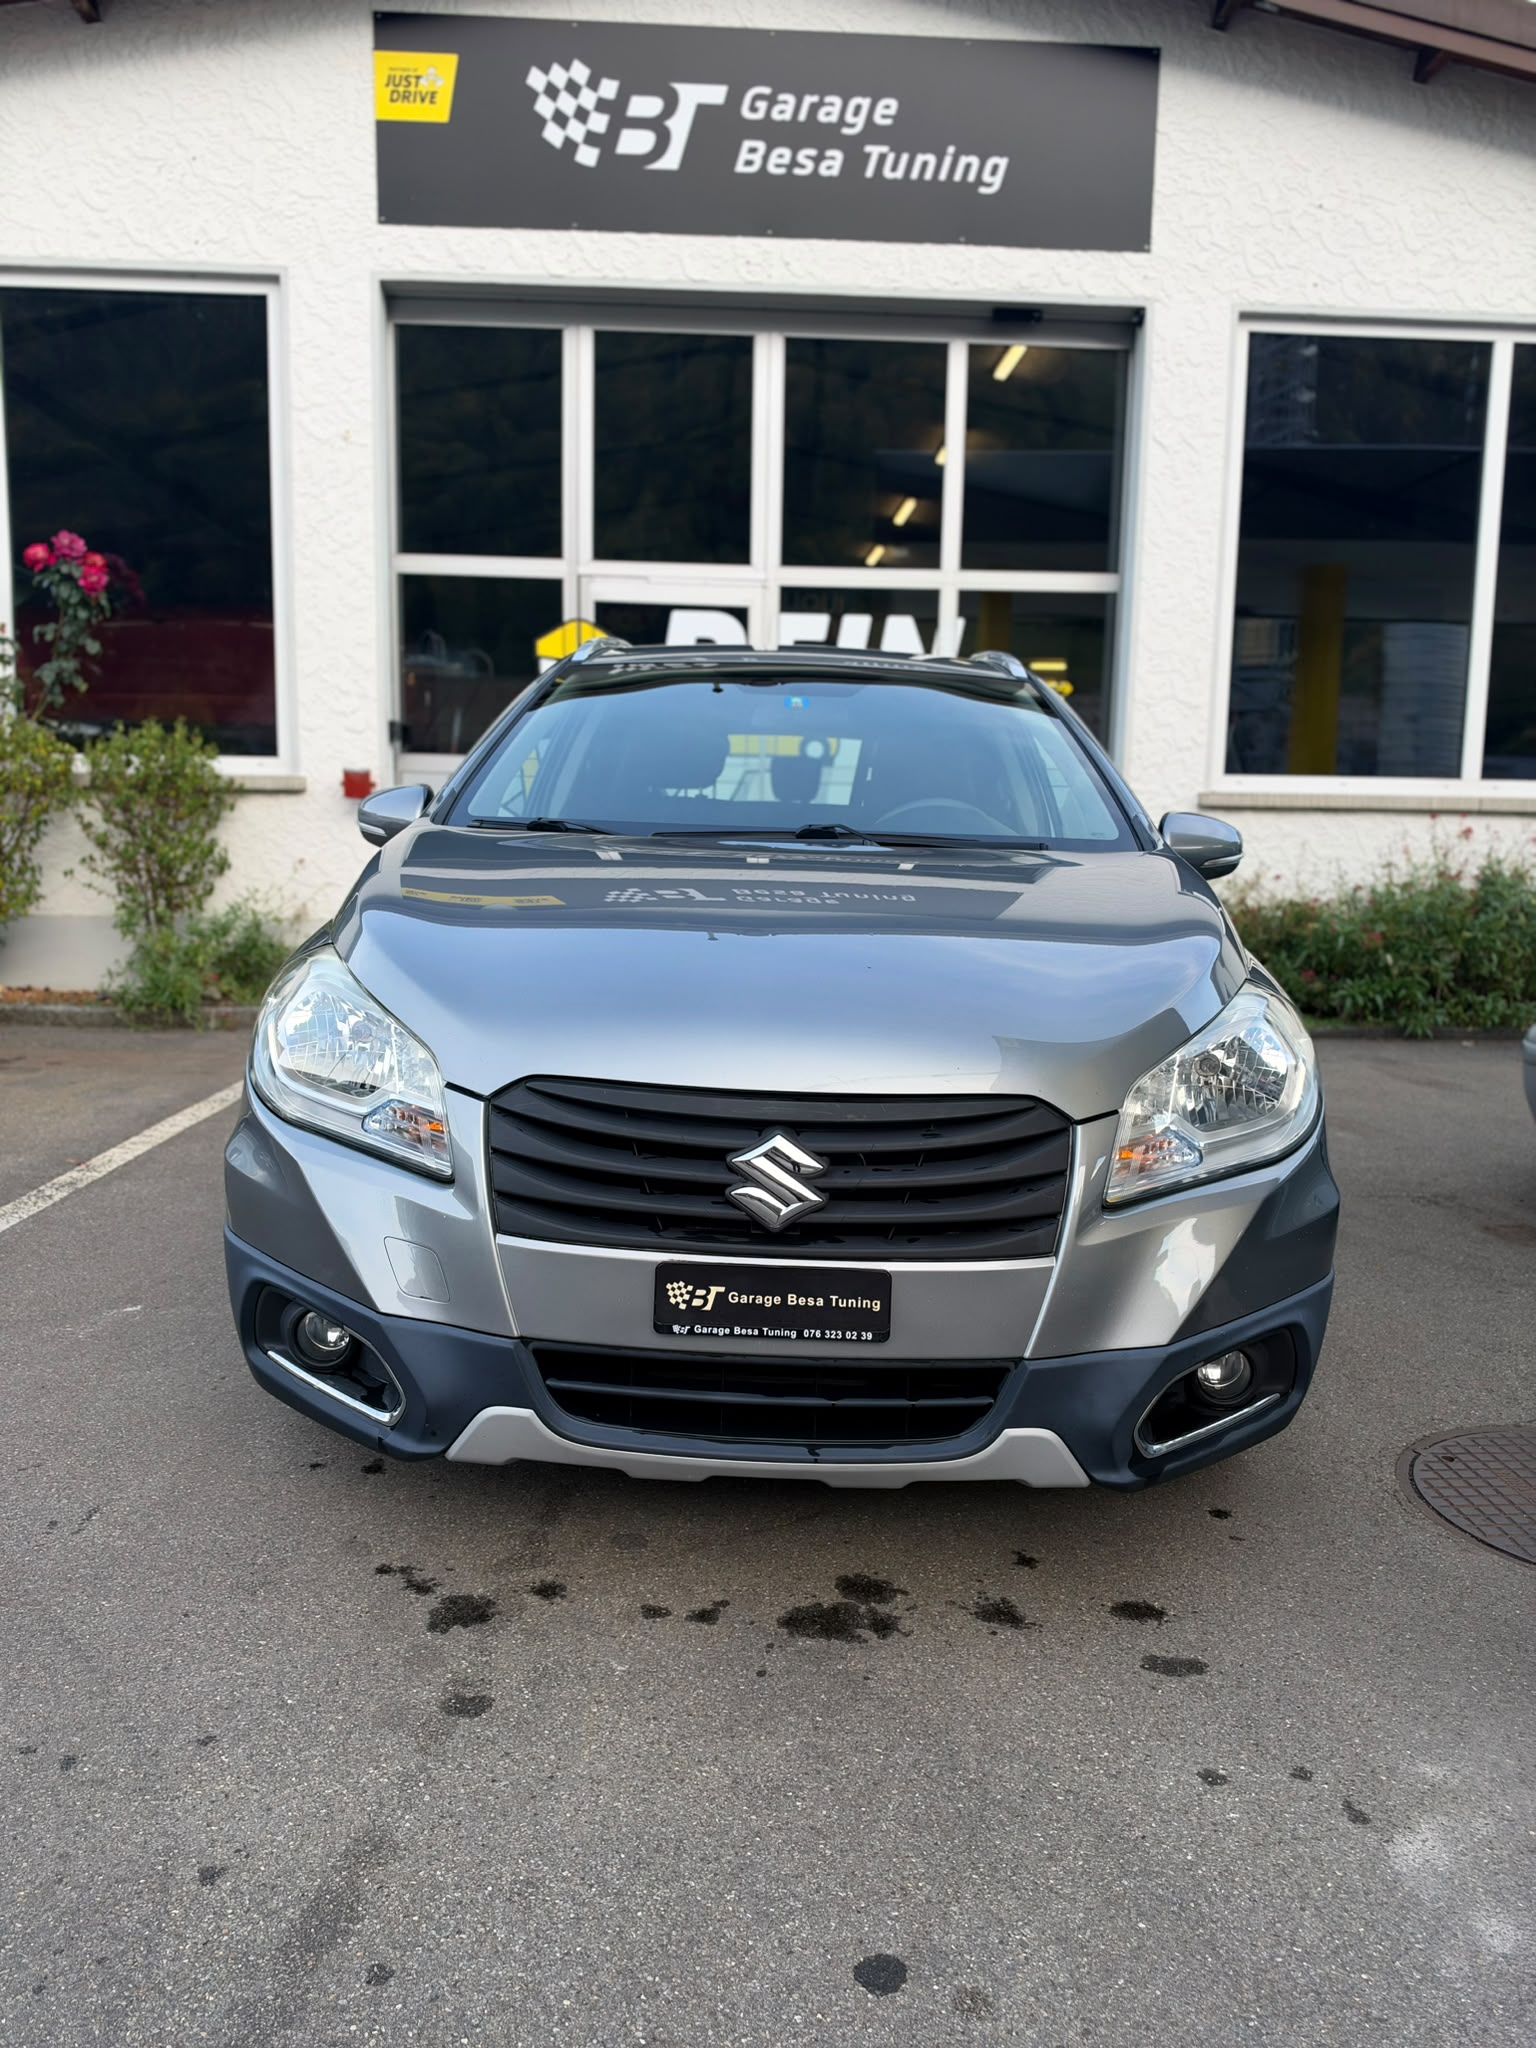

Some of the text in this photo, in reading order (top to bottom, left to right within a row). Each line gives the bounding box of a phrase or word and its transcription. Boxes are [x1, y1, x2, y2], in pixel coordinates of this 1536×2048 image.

[385, 74, 422, 89] JUST
[389, 89, 438, 105] DRIVE
[740, 85, 899, 136] Garage
[733, 139, 1010, 195] Besa Tuning
[728, 1291, 782, 1308] Garage
[787, 1293, 824, 1307] Besa
[829, 1295, 881, 1312] Tuning
[693, 1324, 731, 1337] Garage
[733, 1326, 759, 1336] Besa
[762, 1327, 797, 1339] Tuning
[803, 1328, 821, 1338] 076
[824, 1330, 842, 1339] 323
[845, 1331, 857, 1340] 02
[860, 1331, 873, 1341] 39
